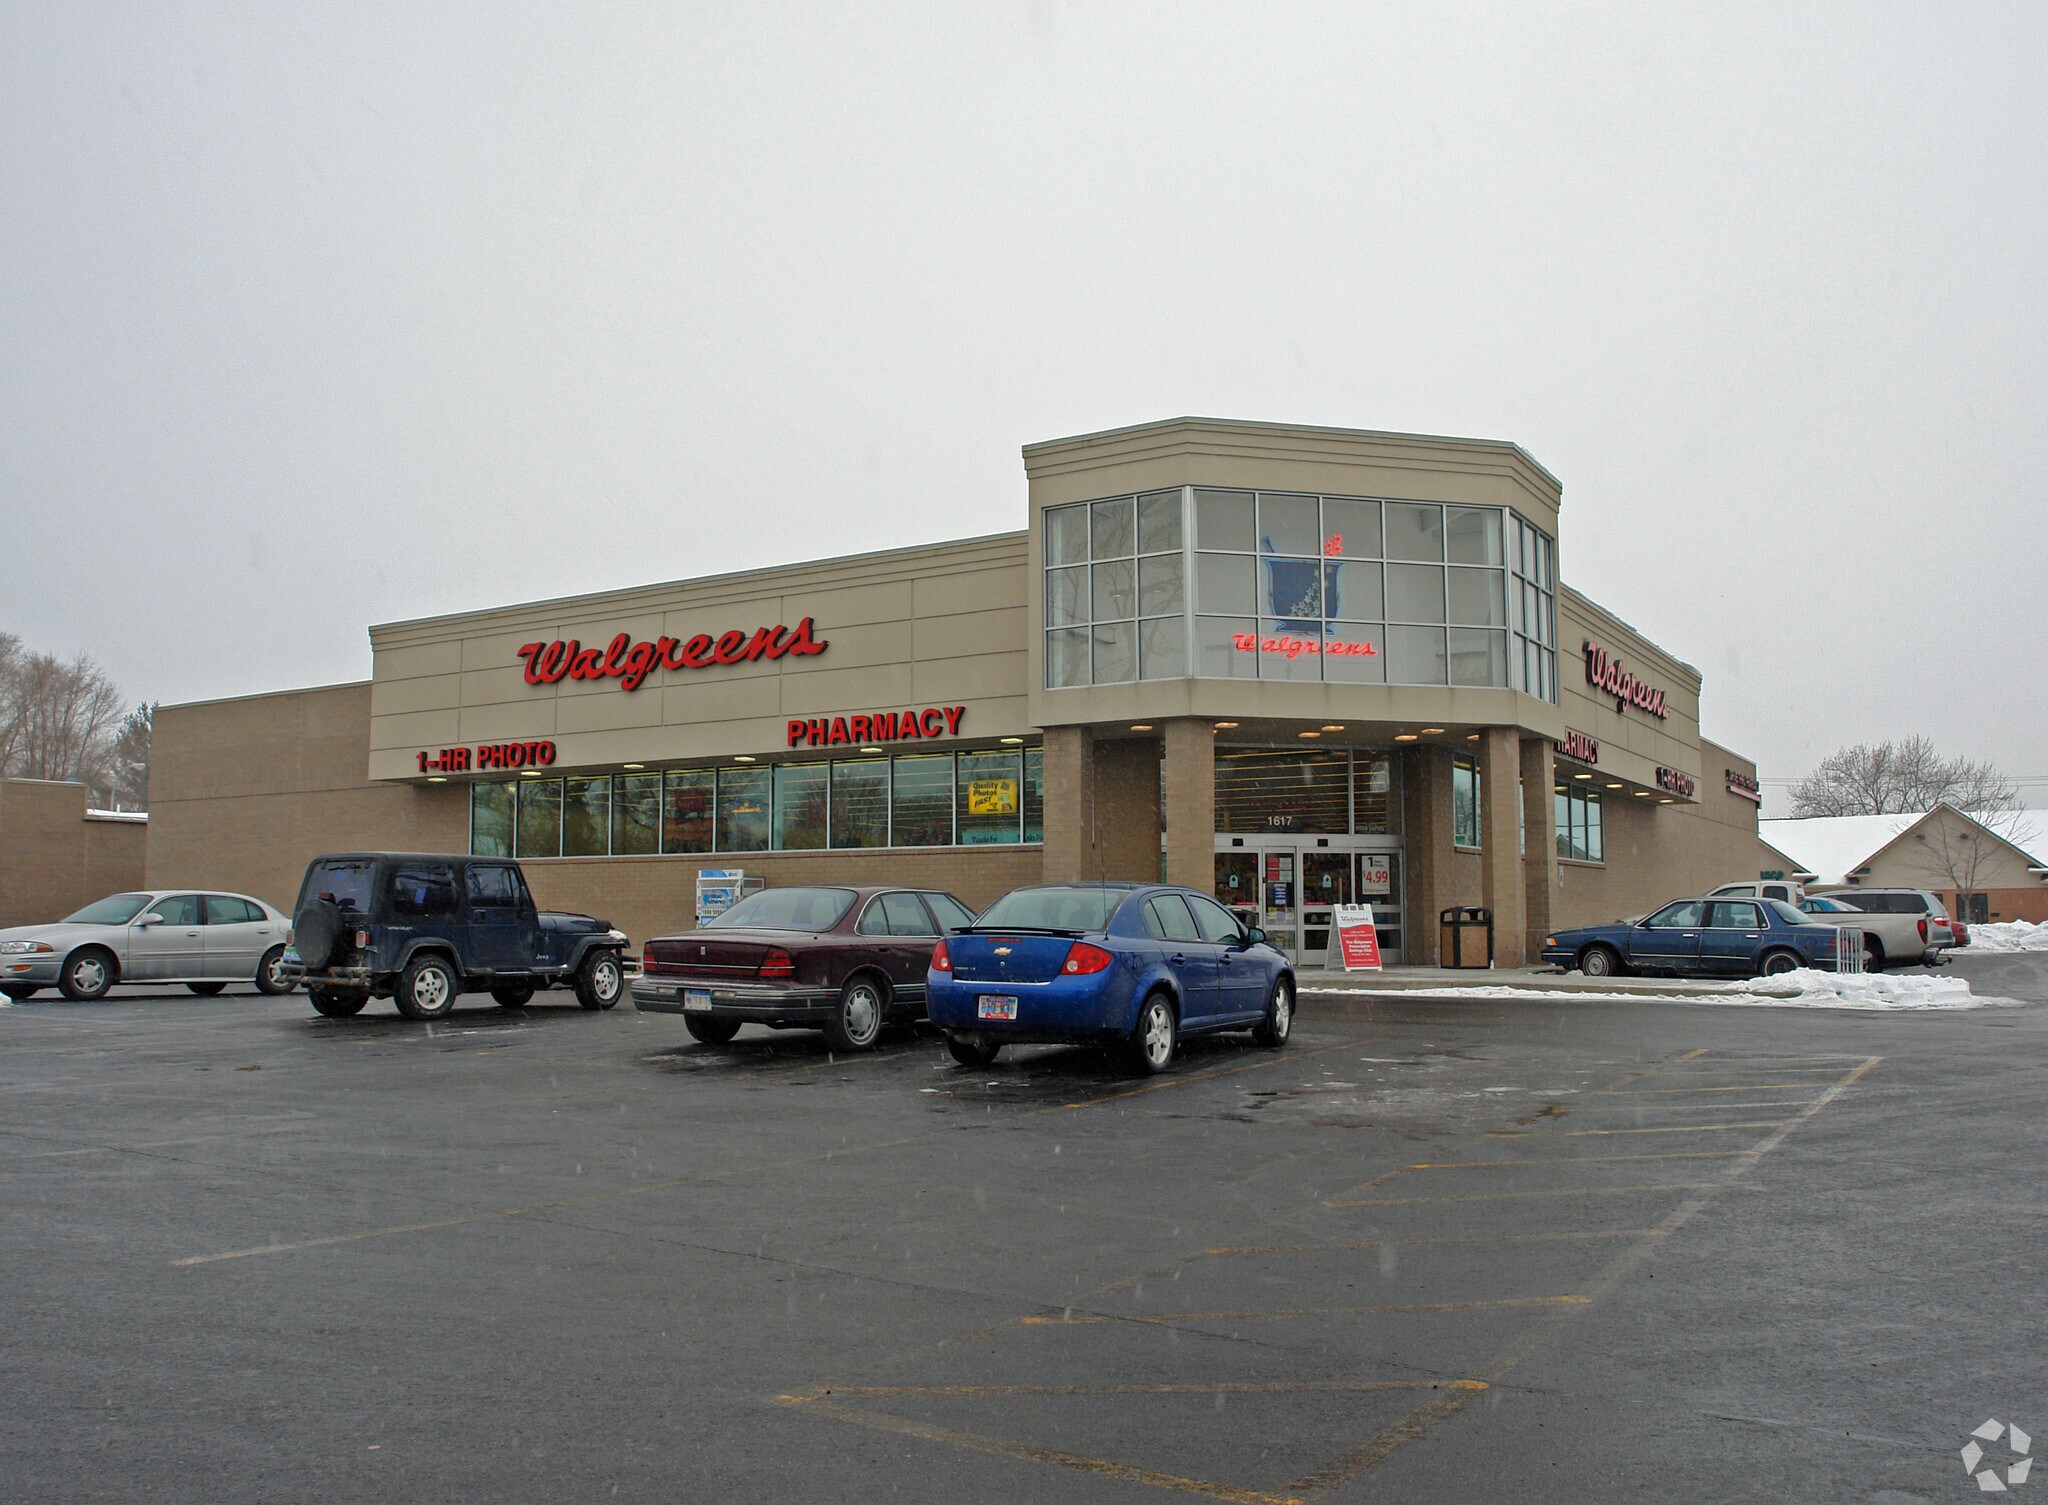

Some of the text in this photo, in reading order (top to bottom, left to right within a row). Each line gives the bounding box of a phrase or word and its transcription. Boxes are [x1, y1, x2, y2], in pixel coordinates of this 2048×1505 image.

[517, 616, 830, 691] Walgreens
[1582, 639, 1670, 719] Walgreens
[787, 706, 966, 748] PHARMACY
[416, 740, 557, 773] 1-HR PHOTO
[973, 781, 998, 789] Quality
[974, 796, 992, 808] FAST
[1267, 816, 1293, 826] 1617
[1367, 856, 1373, 867] 1
[1362, 870, 1388, 883] $4.99
